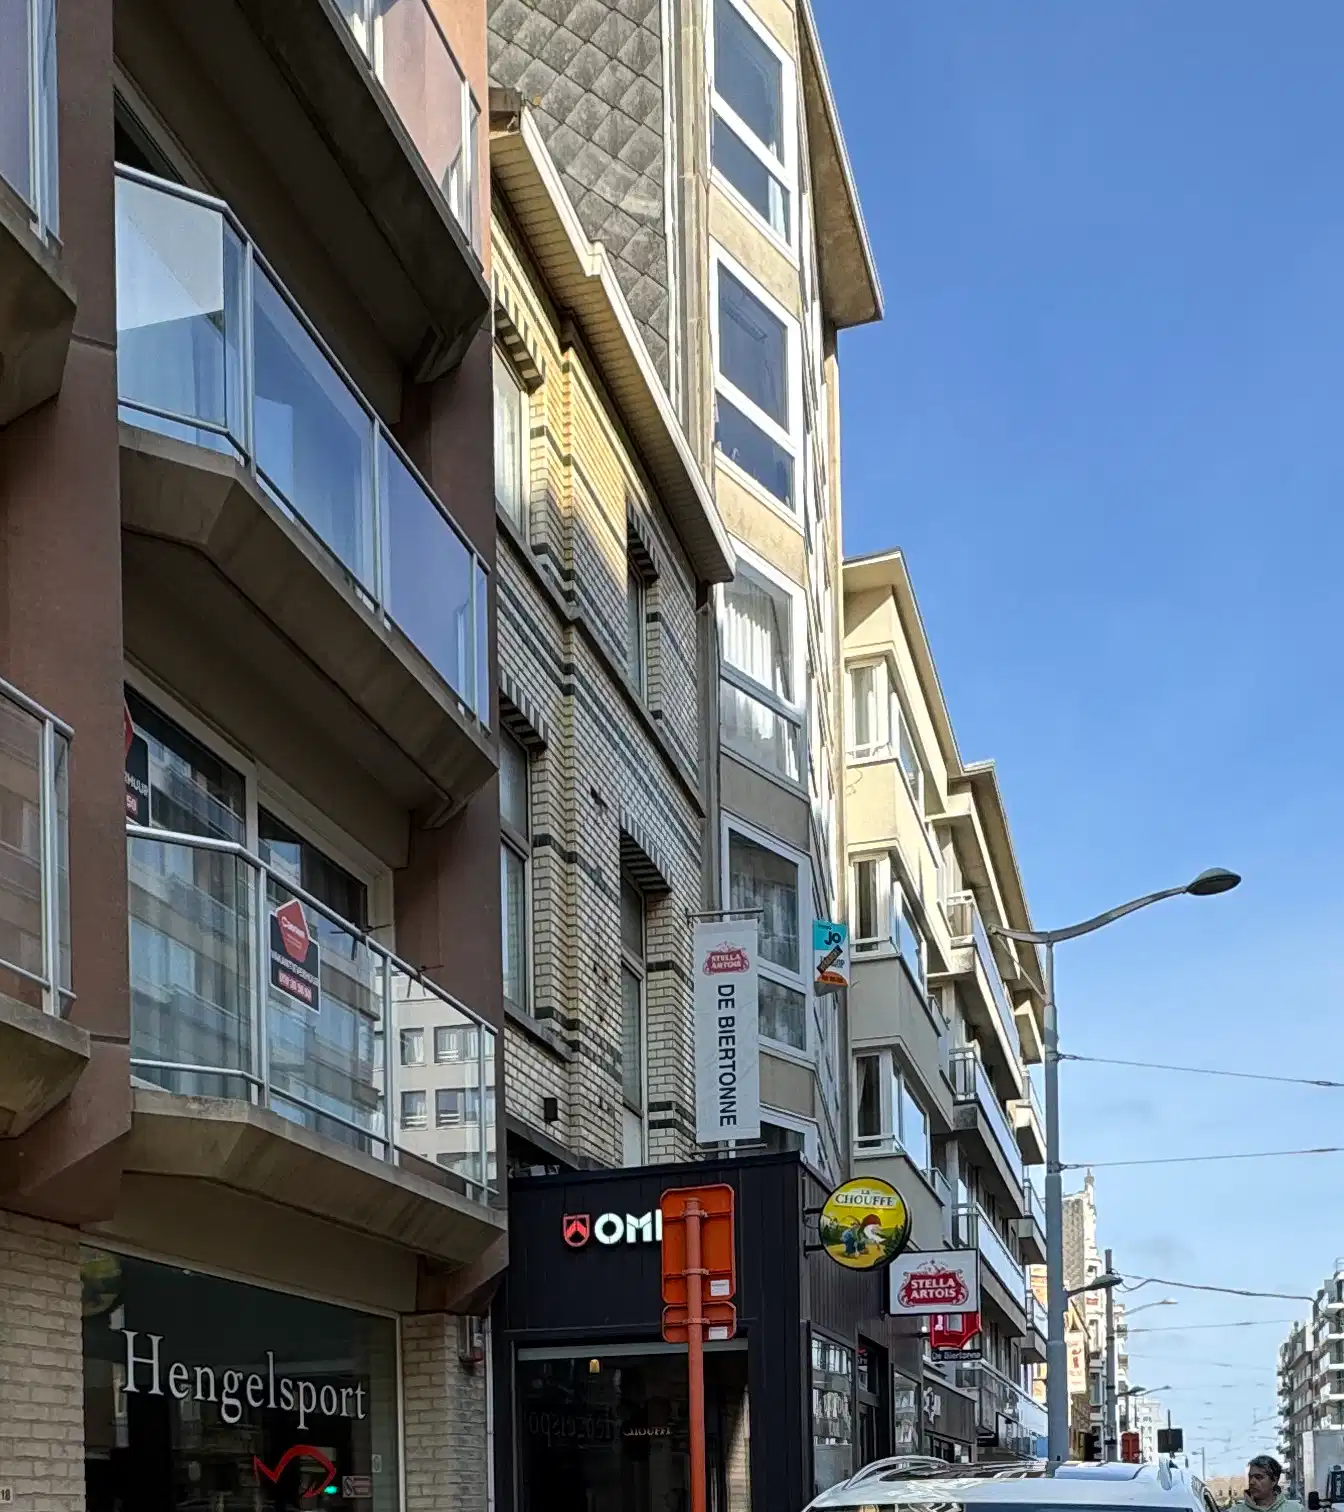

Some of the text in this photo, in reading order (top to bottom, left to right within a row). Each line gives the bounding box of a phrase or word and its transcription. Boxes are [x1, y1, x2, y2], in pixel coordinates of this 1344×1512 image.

[717, 984, 737, 1127] DE BIERTONNE
[835, 1193, 893, 1206] CHOUFFE
[594, 1209, 663, 1245] OM
[910, 1278, 955, 1289] STELLA
[910, 1287, 957, 1300] ARTOIS
[120, 1329, 366, 1431] Hengelsport
